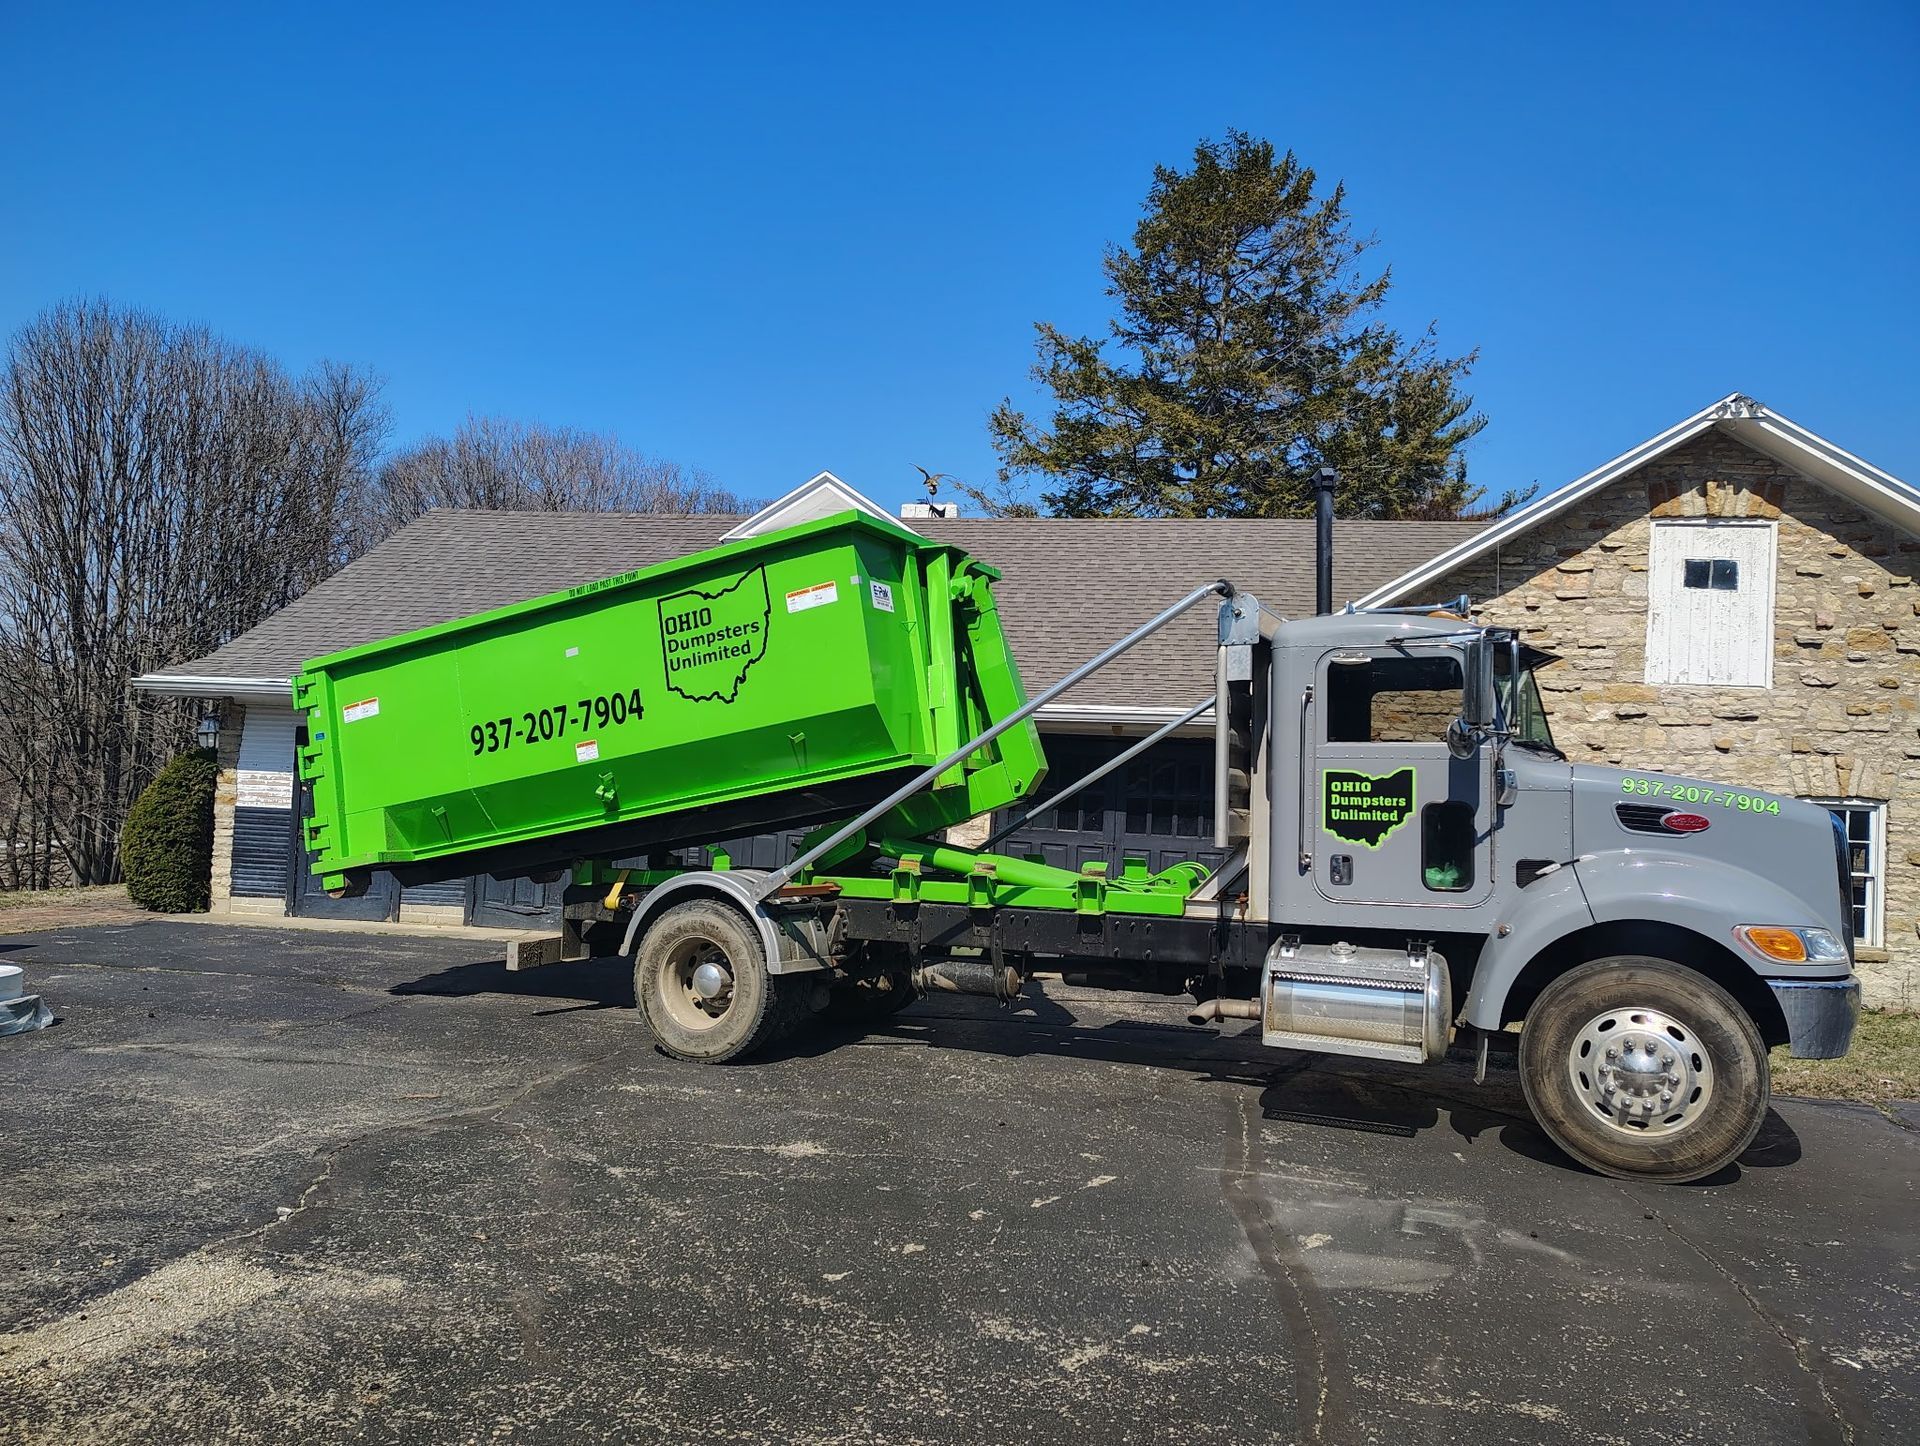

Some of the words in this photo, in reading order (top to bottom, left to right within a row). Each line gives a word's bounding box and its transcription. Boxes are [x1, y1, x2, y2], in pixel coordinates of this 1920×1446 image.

[568, 589, 576, 598] DO
[577, 586, 586, 595] NOT
[586, 582, 599, 593] LOAD
[600, 579, 612, 589] PAST
[612, 576, 625, 586] THIS
[625, 570, 639, 583] POINT
[664, 607, 712, 636] OHIO
[667, 621, 760, 654] Dumpsters
[669, 639, 751, 672] Unlimited
[470, 688, 645, 757] 937-207-7904
[1330, 781, 1372, 793] OHIO
[1330, 793, 1407, 809] Dumpsters
[1621, 776, 1782, 817] 937-207-7904
[1330, 808, 1399, 822] Unlimited
